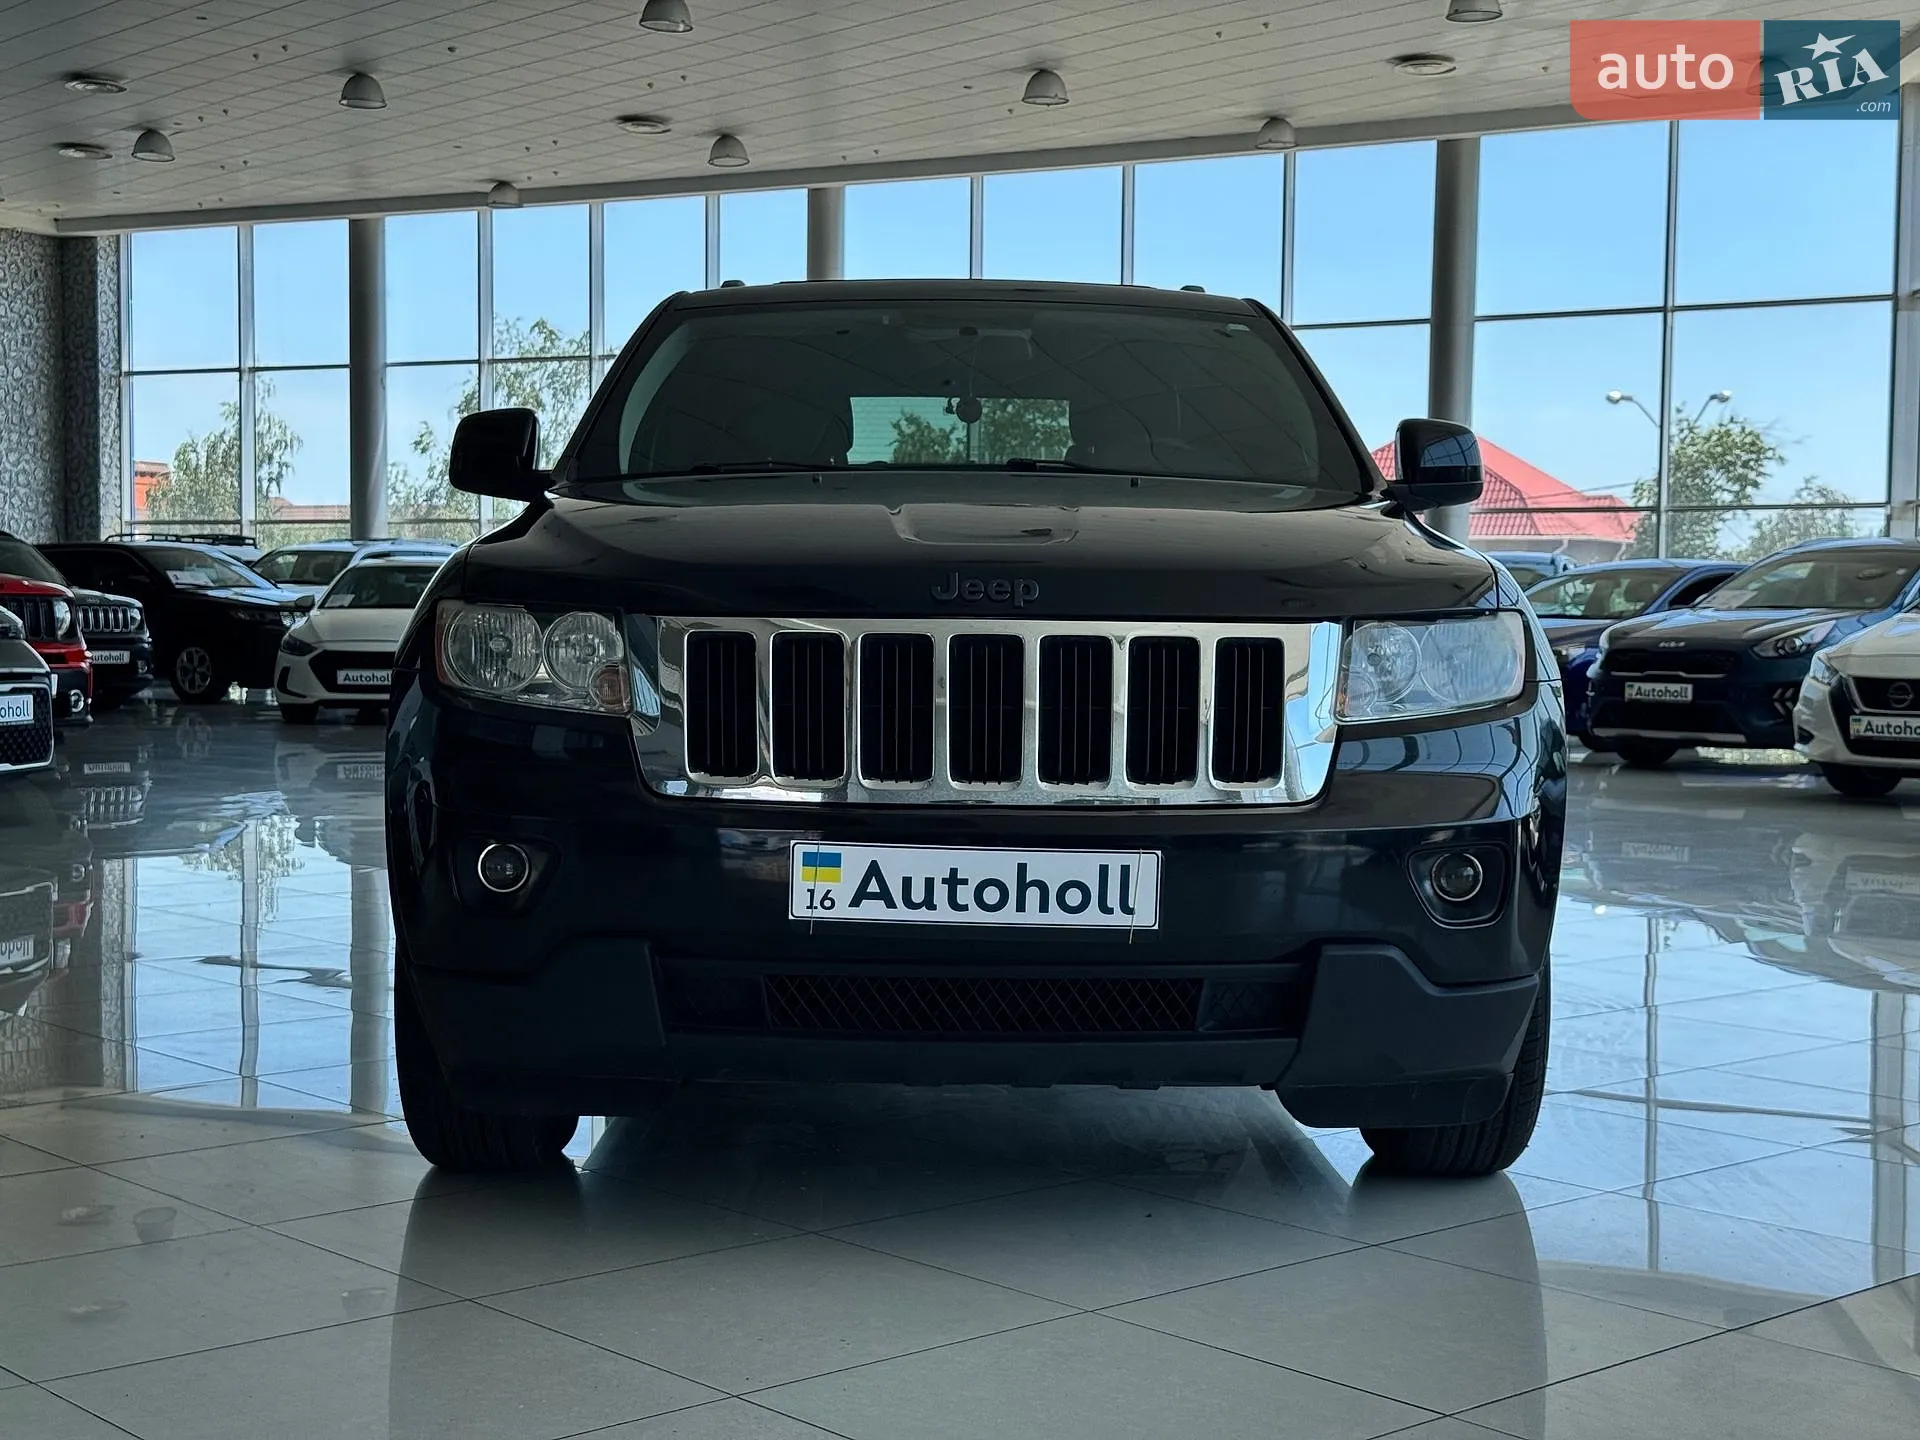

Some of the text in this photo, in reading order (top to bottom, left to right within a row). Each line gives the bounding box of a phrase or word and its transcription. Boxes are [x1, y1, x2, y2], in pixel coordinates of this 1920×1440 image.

[930, 570, 1040, 608] Jeep
[93, 652, 125, 662] utoholl
[343, 672, 391, 682] Autohol
[1634, 684, 1689, 699] Autoholl
[0, 699, 30, 719] oholl
[1863, 719, 1920, 736] Autoho
[805, 859, 1136, 916] 16 Autoholl
